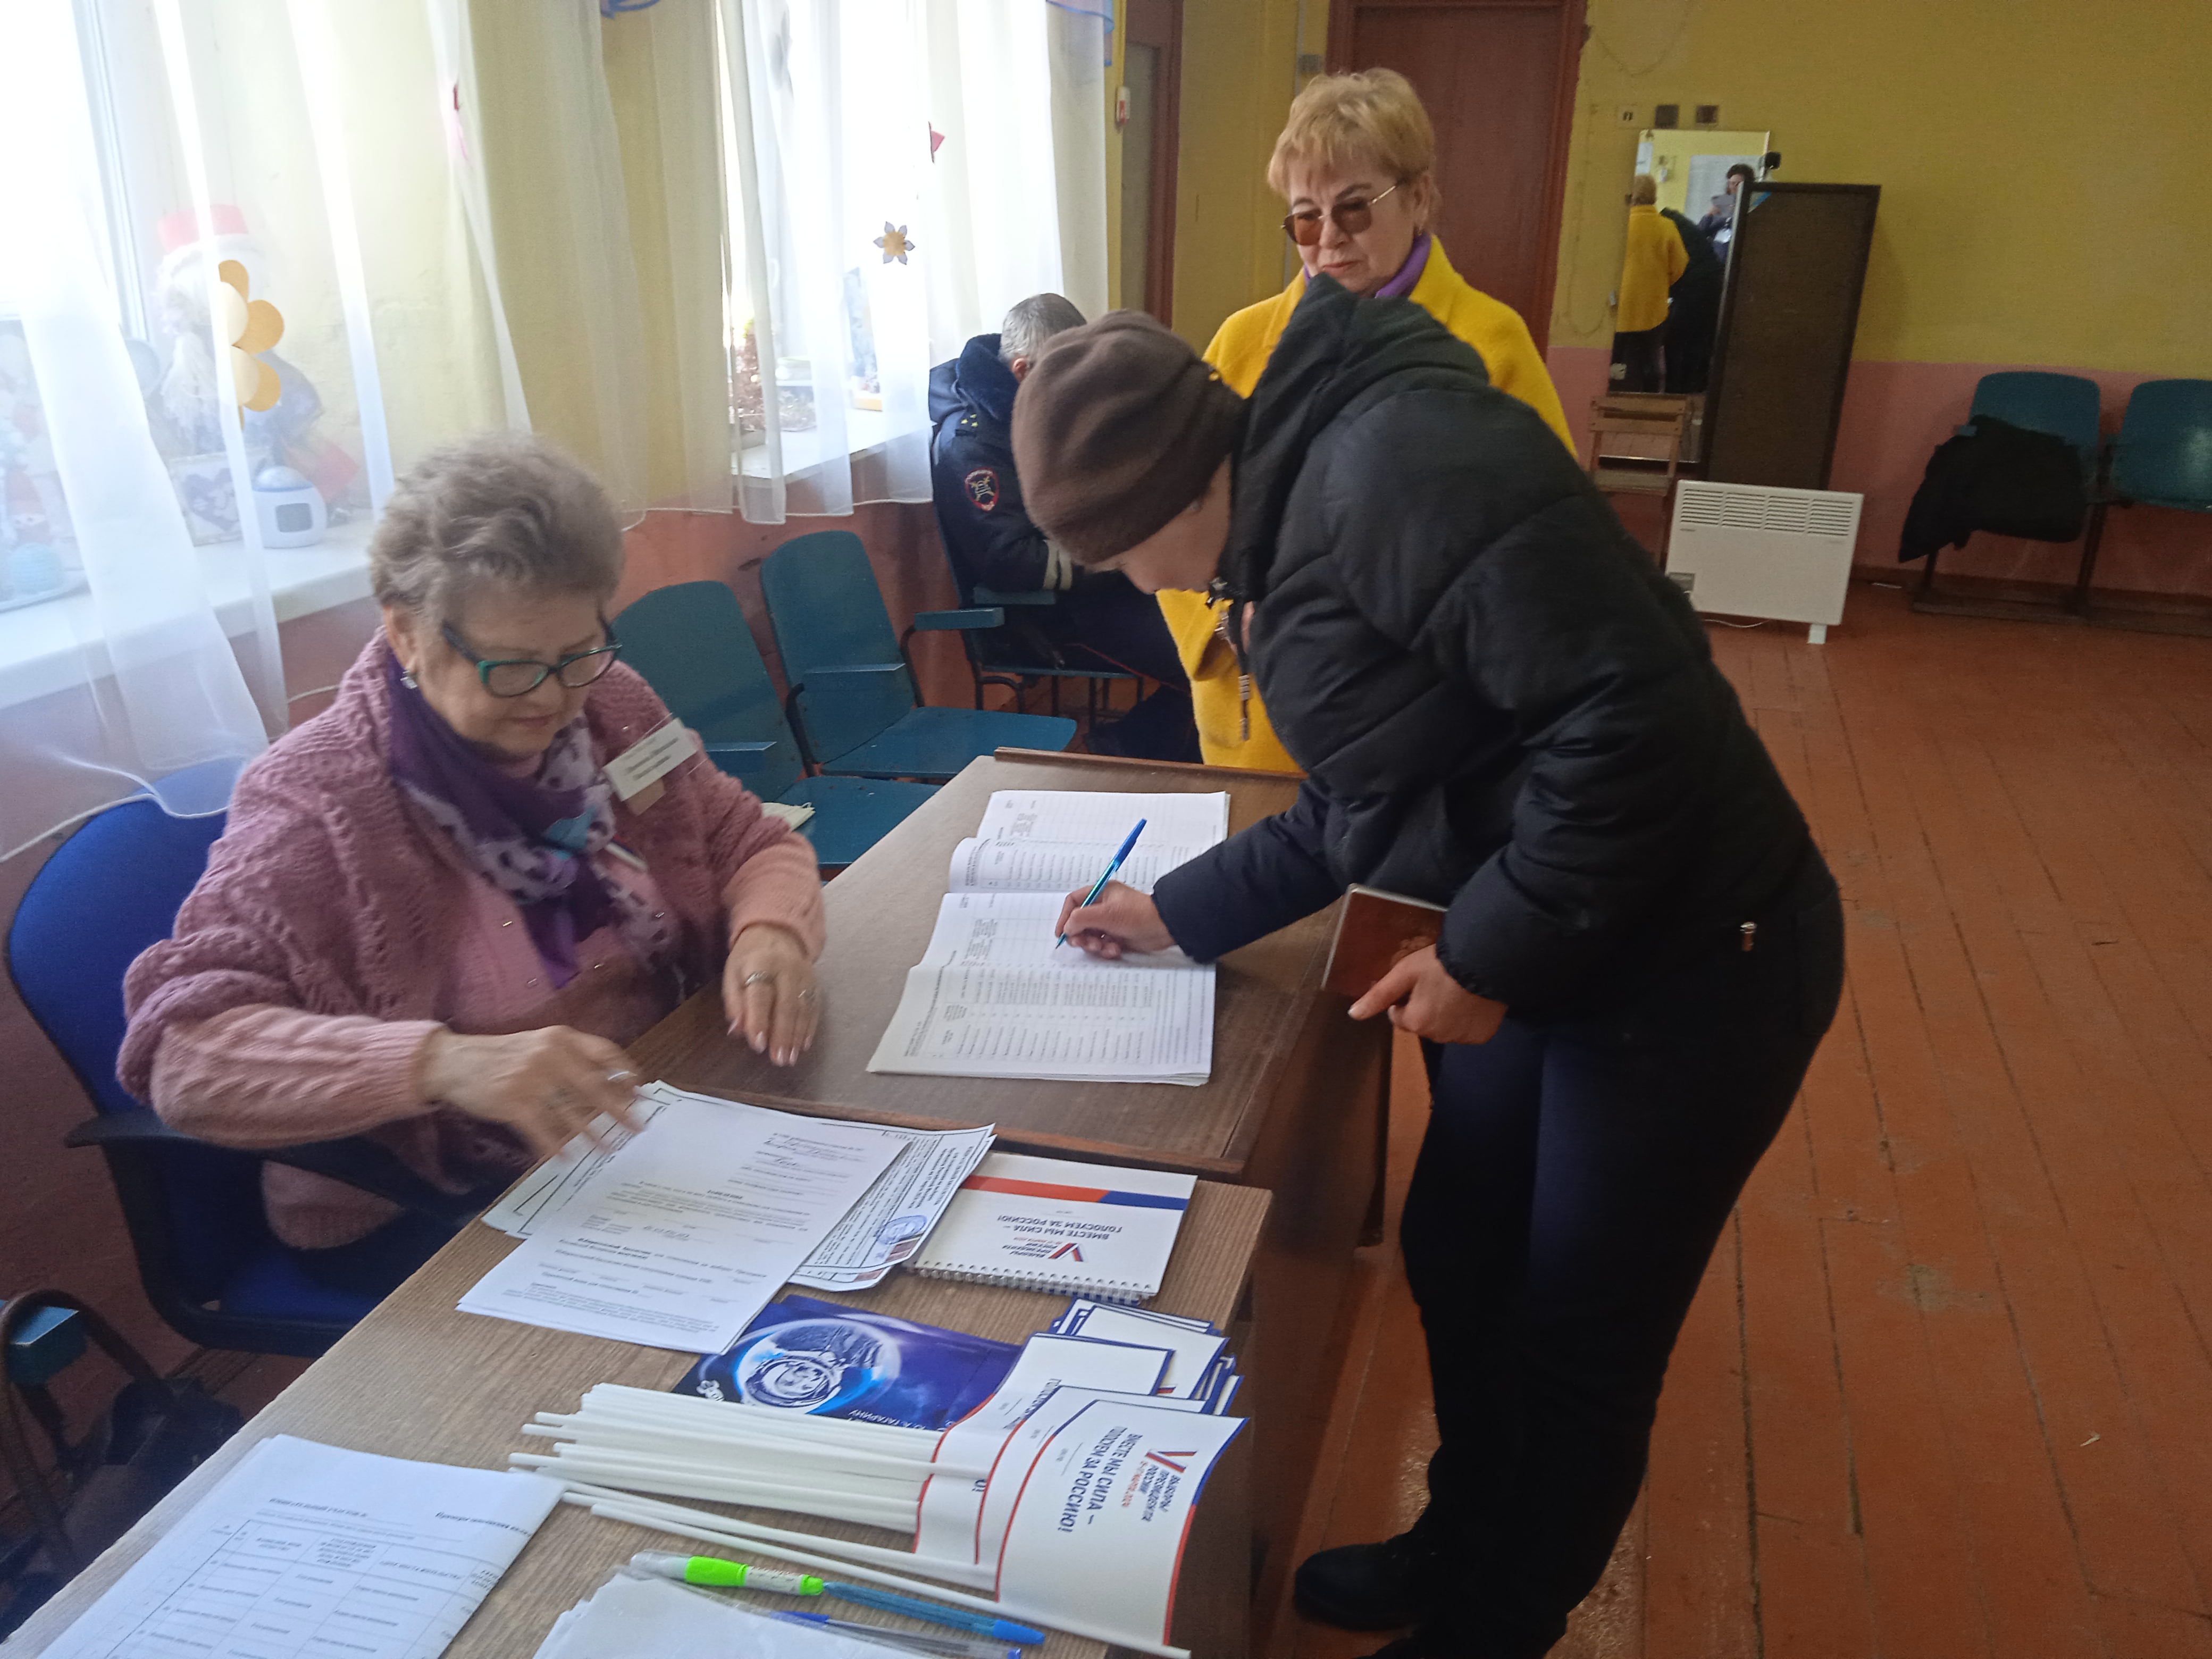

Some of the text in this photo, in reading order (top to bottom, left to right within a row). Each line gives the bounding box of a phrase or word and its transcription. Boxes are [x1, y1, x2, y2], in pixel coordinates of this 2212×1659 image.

[997, 1214, 1048, 1226] РОССИЮ!
[1013, 1225, 1042, 1233] СИЛА
[1064, 1222, 1123, 1233] ГОЛОСУЕМ
[1066, 1230, 1110, 1240] ВМЕСТЕ
[1112, 1434, 1143, 1458] ВМЕСТЕ
[1082, 1457, 1101, 1469] ЗА
[1101, 1457, 1124, 1476] МЫ
[1086, 1477, 1113, 1510] СИЛА
[1058, 1471, 1094, 1532] РОССИЮ!
